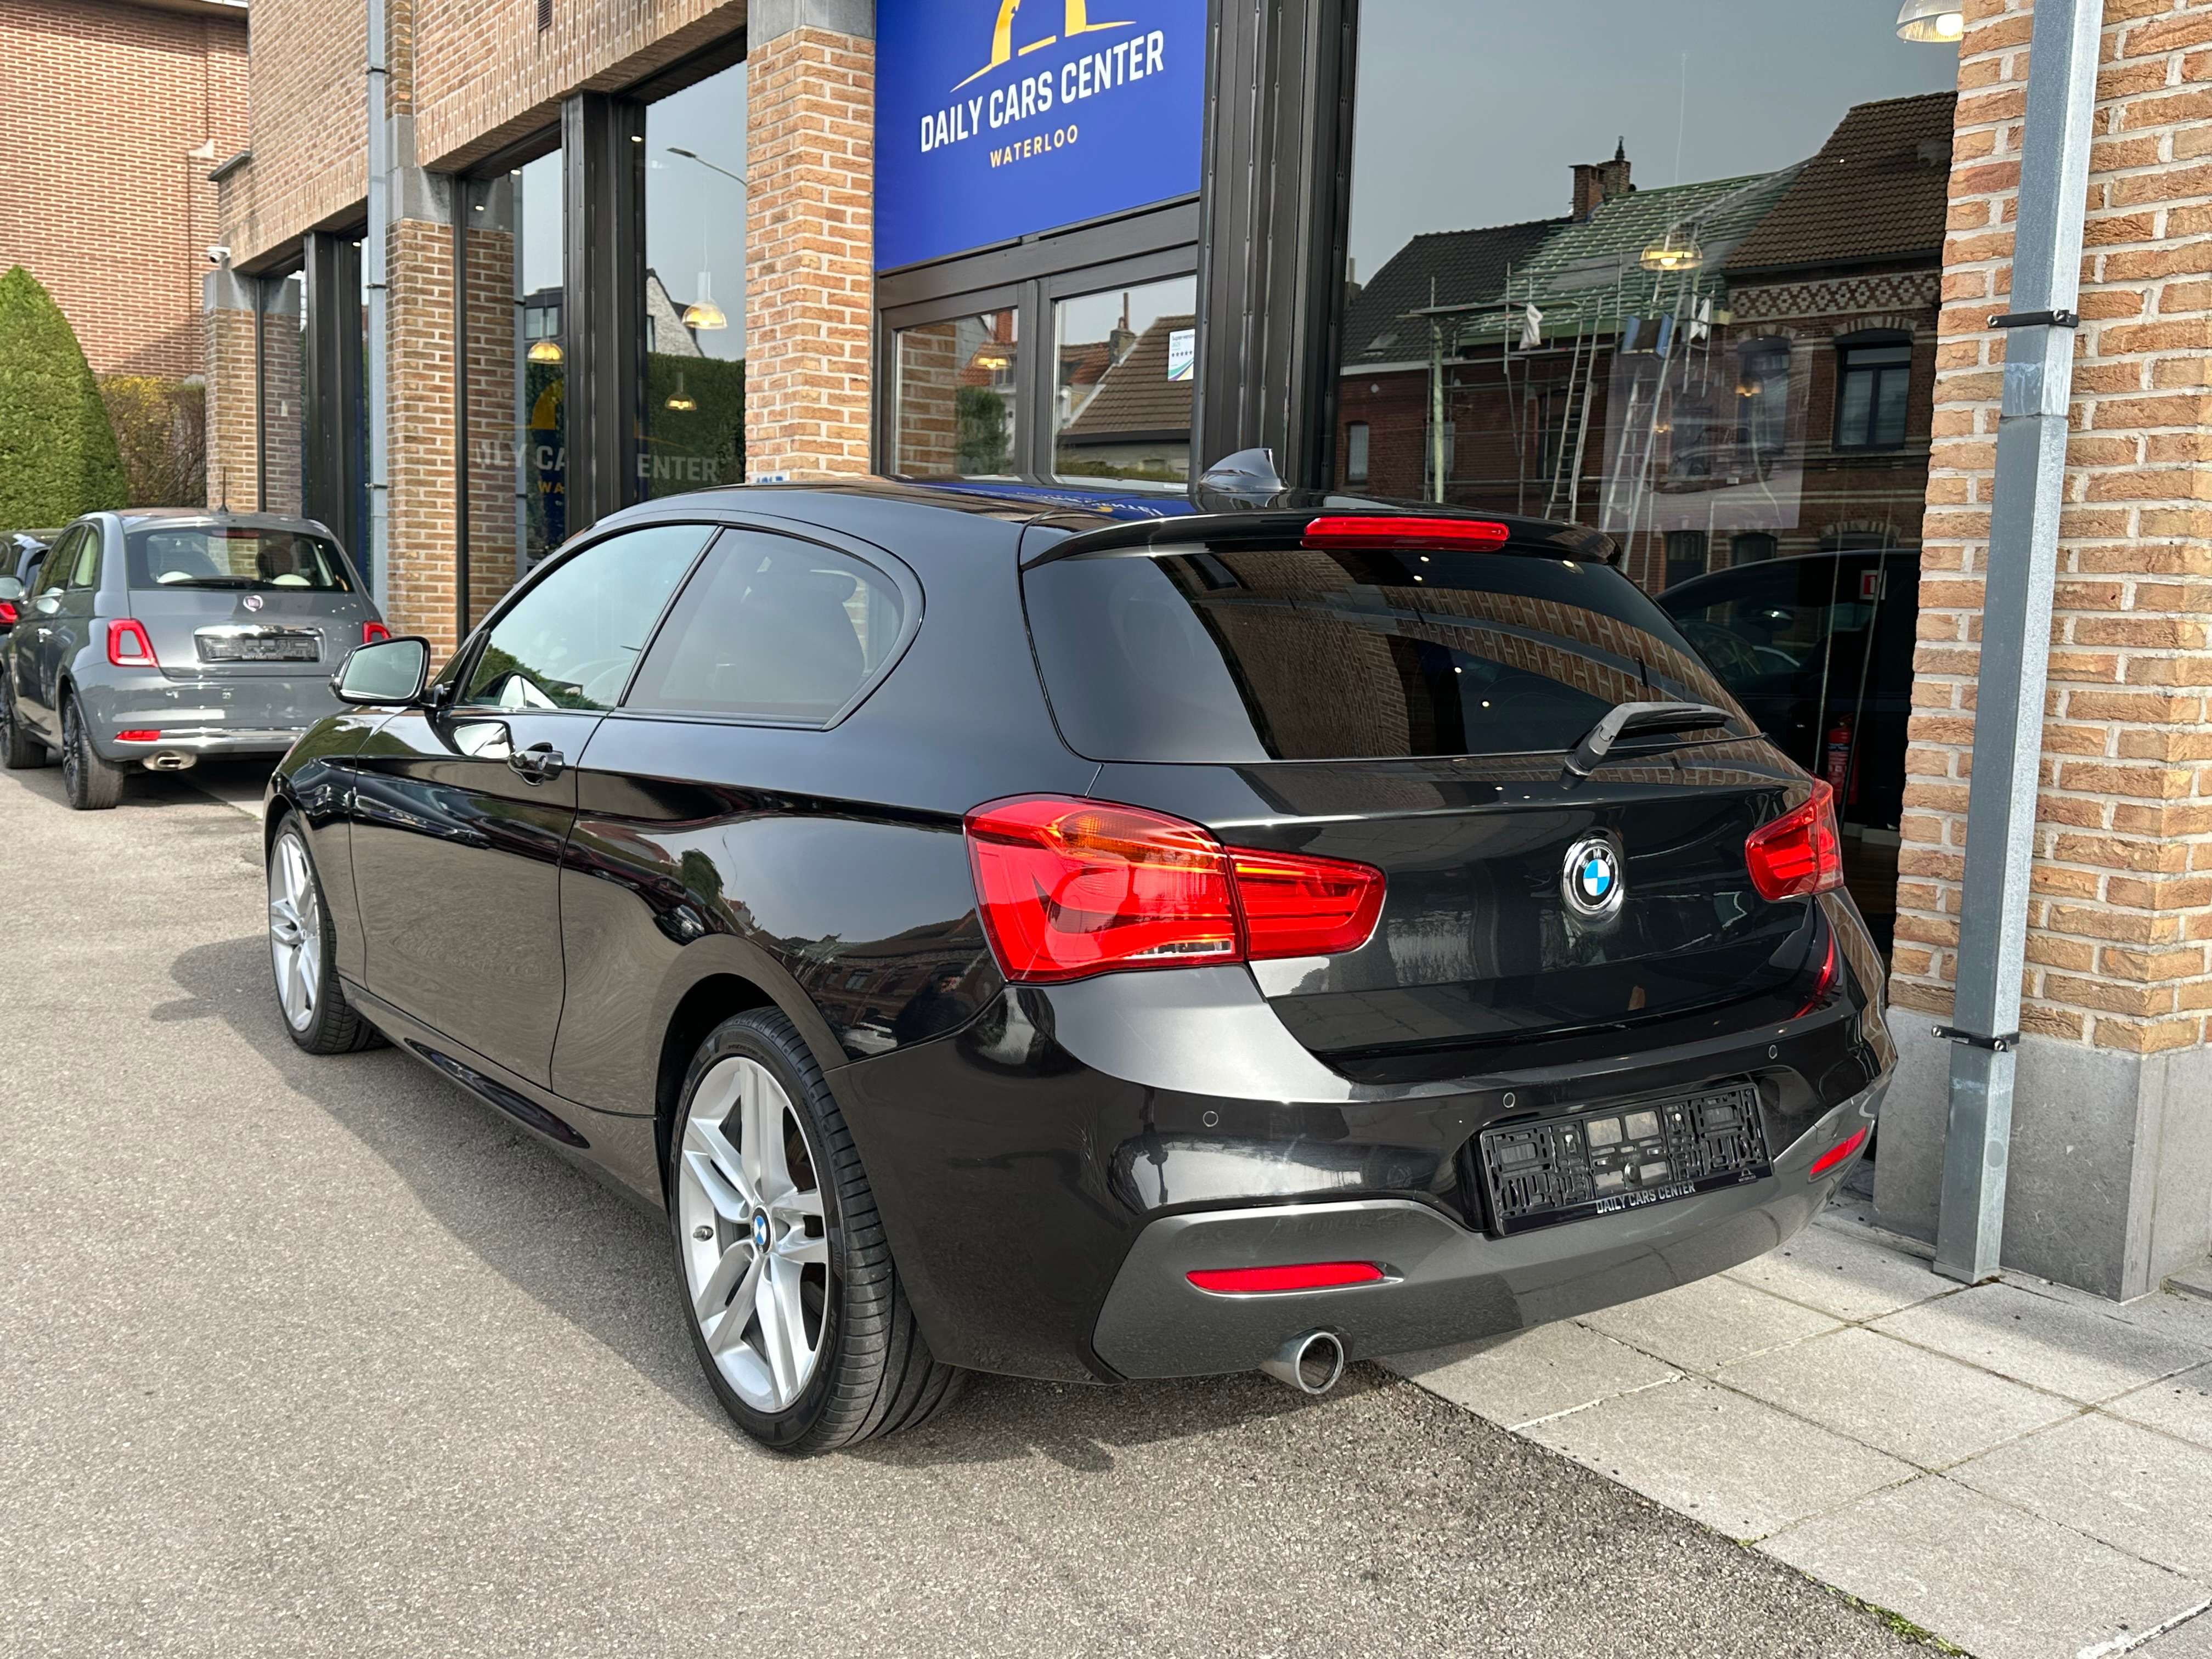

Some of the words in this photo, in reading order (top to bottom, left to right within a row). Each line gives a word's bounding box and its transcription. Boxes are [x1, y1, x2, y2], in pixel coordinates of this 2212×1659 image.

[921, 95, 983, 153] DAILY
[989, 71, 1052, 129] CARS
[1061, 30, 1164, 104] CENTER
[990, 125, 1079, 168] WATERLOO
[636, 453, 718, 482] ENTER
[1596, 1194, 1627, 1214] DAILY
[1628, 1190, 1657, 1207] CARS
[1659, 1180, 1696, 1200] CENTER
